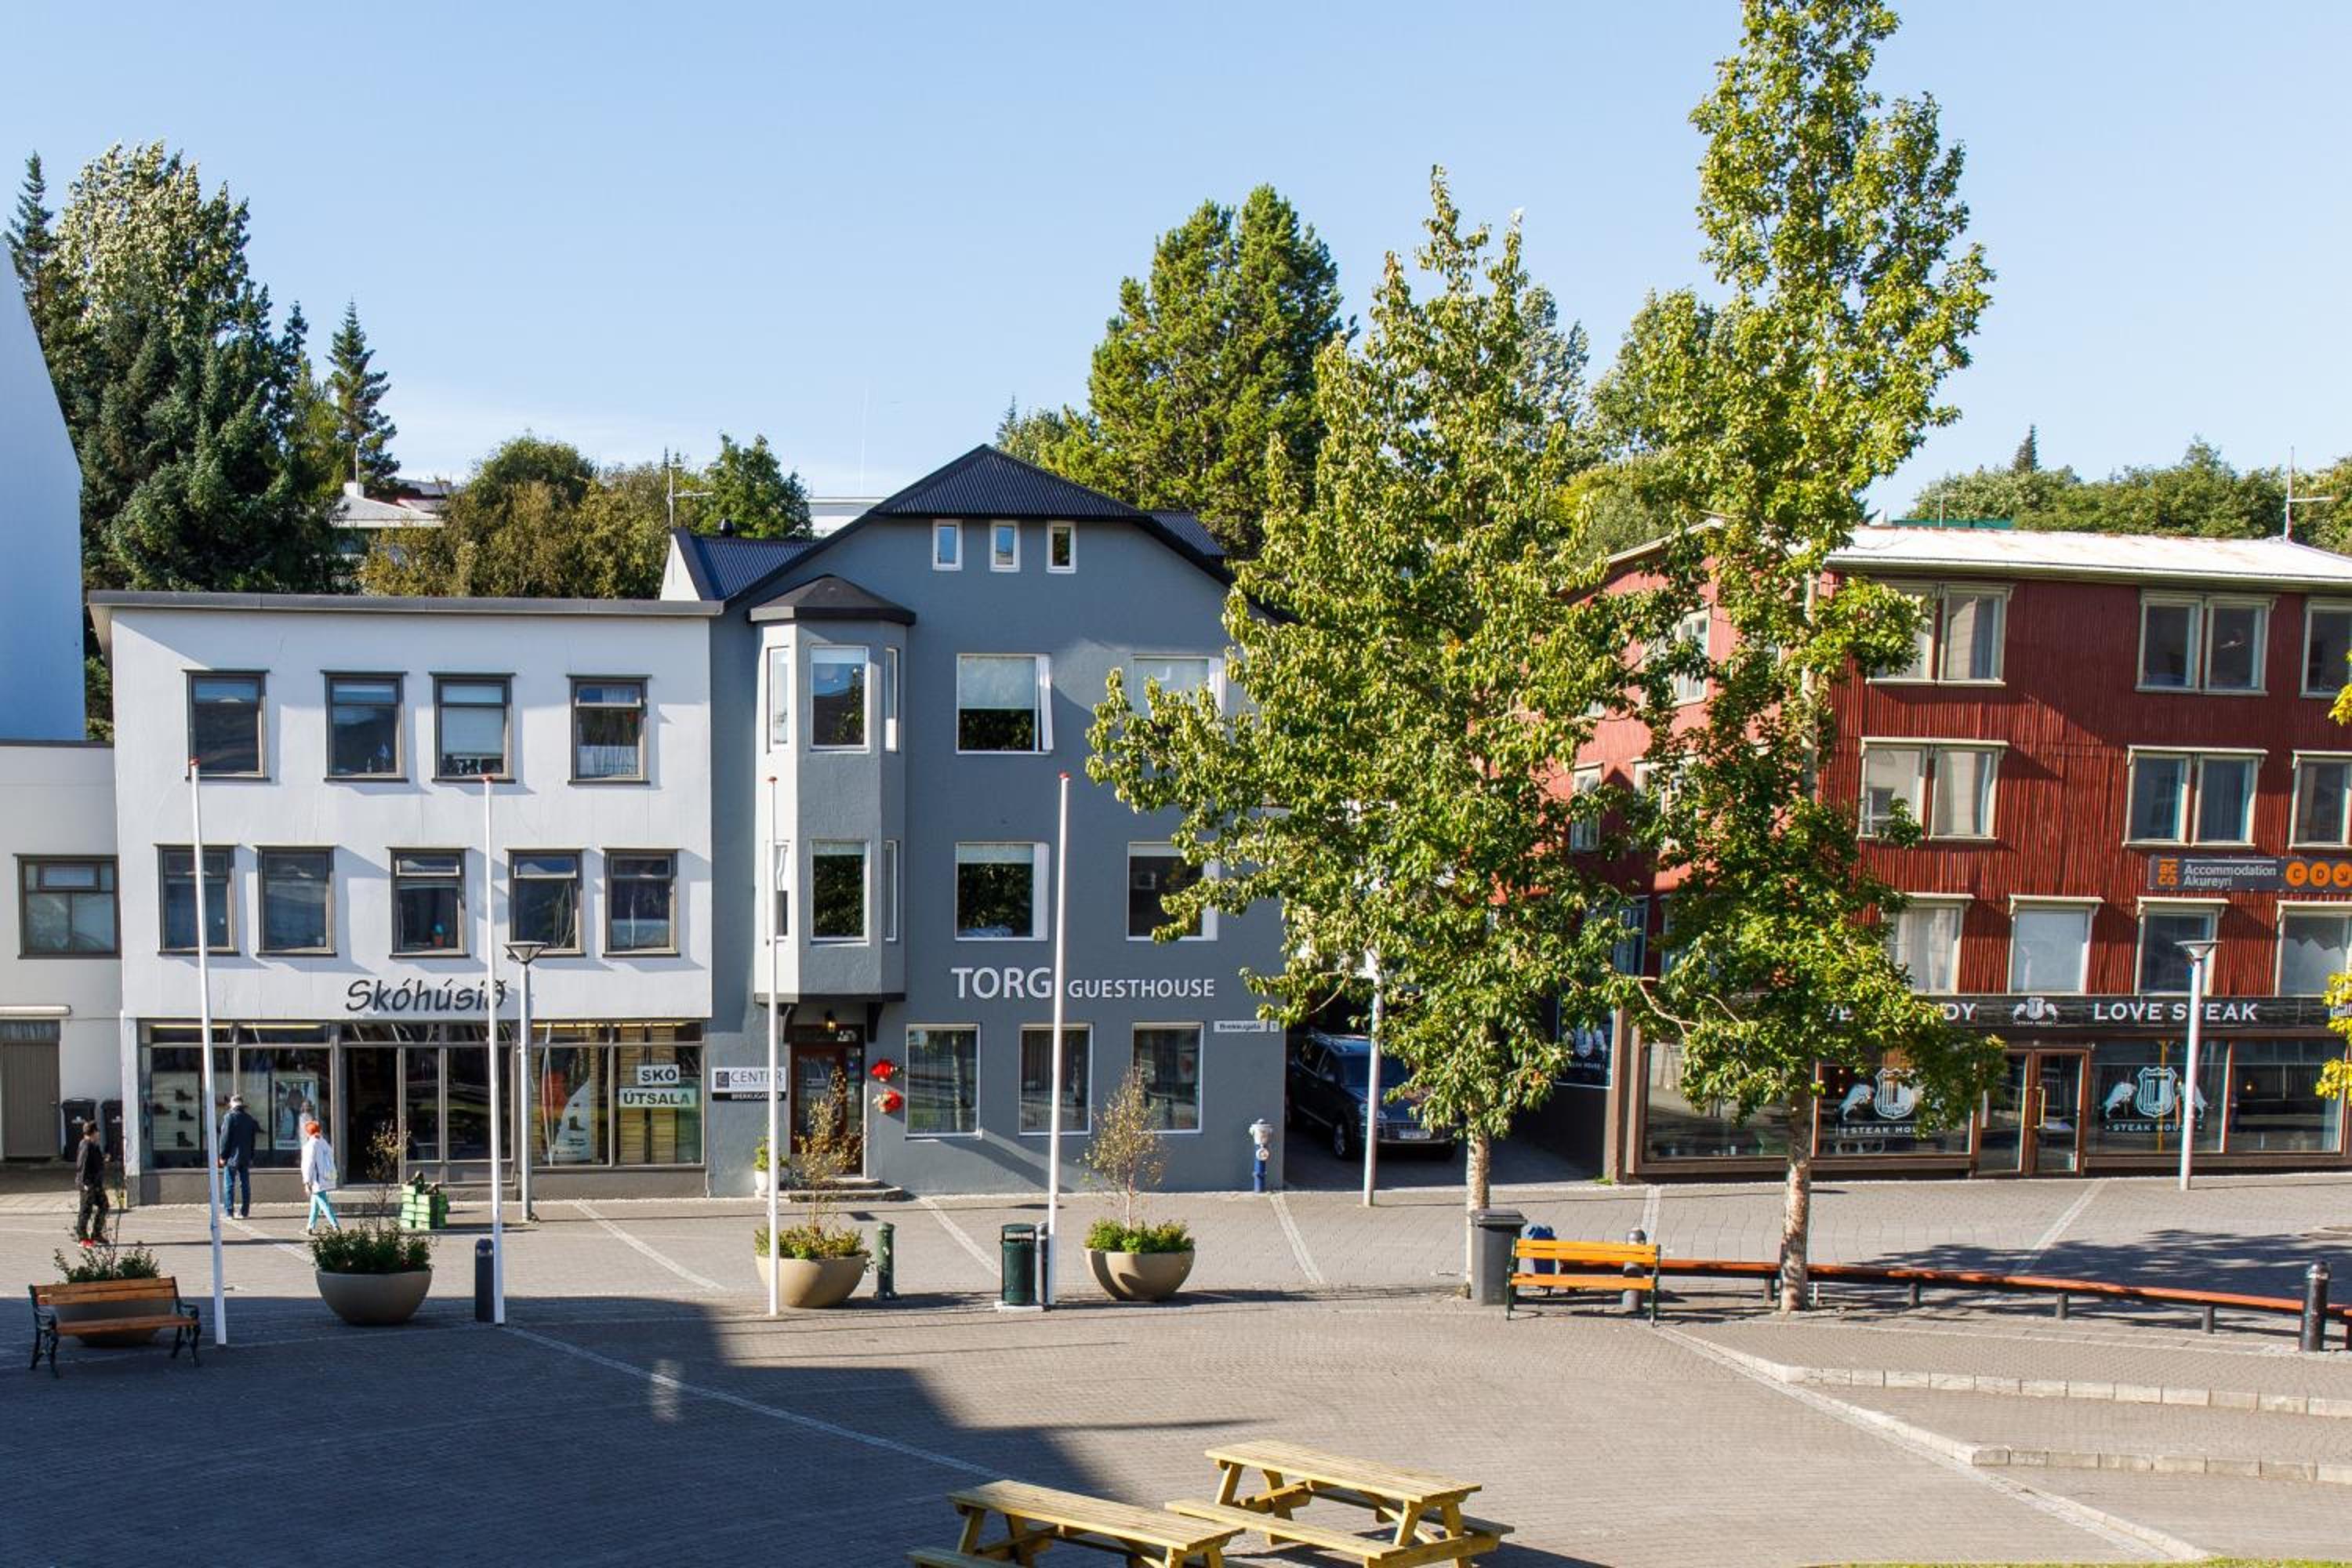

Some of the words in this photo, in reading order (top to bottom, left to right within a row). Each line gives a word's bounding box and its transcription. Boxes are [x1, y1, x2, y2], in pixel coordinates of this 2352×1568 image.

[2183, 864, 2277, 877] Accommodation
[2183, 876, 2233, 889] Akureyri
[950, 967, 1052, 999] TORG
[1068, 978, 1215, 997] GUESTHOUSE
[2093, 1003, 2163, 1021] LOVE
[2172, 1003, 2258, 1021] SEAK
[641, 1066, 677, 1081] SKÓ
[623, 1090, 691, 1105] ÚTSALA
[1850, 1126, 1889, 1135] STEAK
[2113, 1123, 2151, 1131] STEAK
